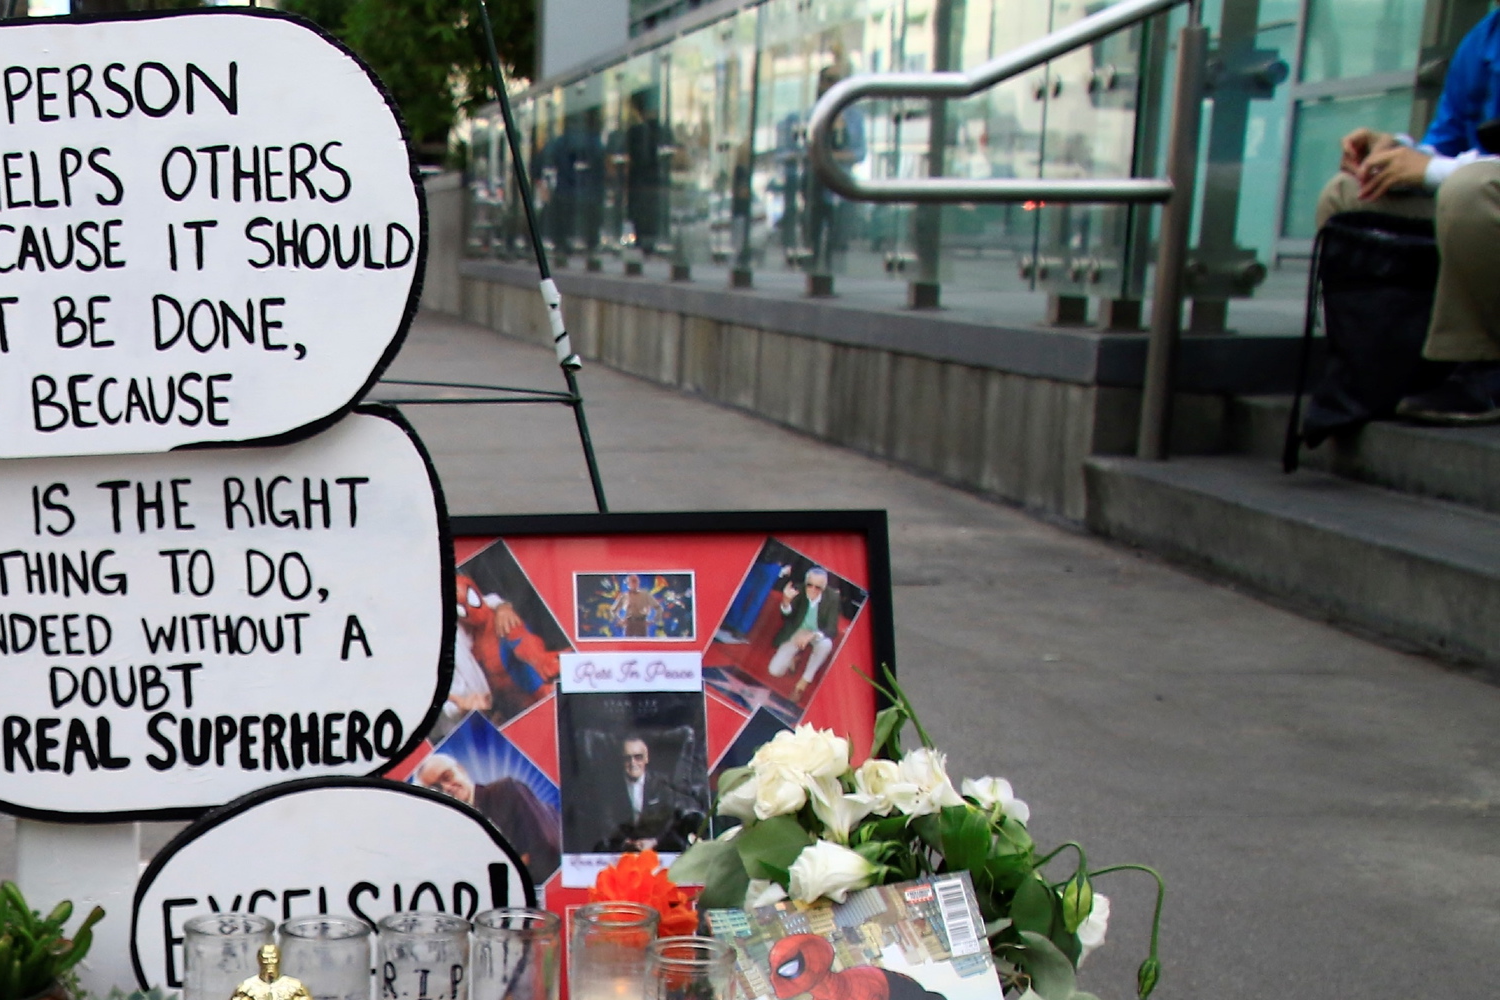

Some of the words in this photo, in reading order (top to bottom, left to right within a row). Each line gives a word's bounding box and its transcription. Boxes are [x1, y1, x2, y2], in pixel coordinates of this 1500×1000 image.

[4, 62, 237, 124] PERSON
[162, 142, 351, 203] OTHERS
[169, 220, 217, 271] IT
[245, 217, 414, 269] SHOULD
[54, 296, 114, 348] BE
[152, 294, 306, 360] DONE,
[32, 372, 232, 432] BECAUSE
[33, 483, 75, 536] IS
[97, 479, 195, 533] THE
[224, 476, 369, 529] RIGHT
[159, 549, 214, 596] TO
[246, 549, 328, 602] DO,
[142, 613, 310, 654] WITHOUT
[341, 615, 372, 660] A
[49, 663, 204, 710] DOUBT
[617, 659, 639, 682] In
[3, 714, 130, 774] REAL
[145, 709, 400, 770] SUPERHERO
